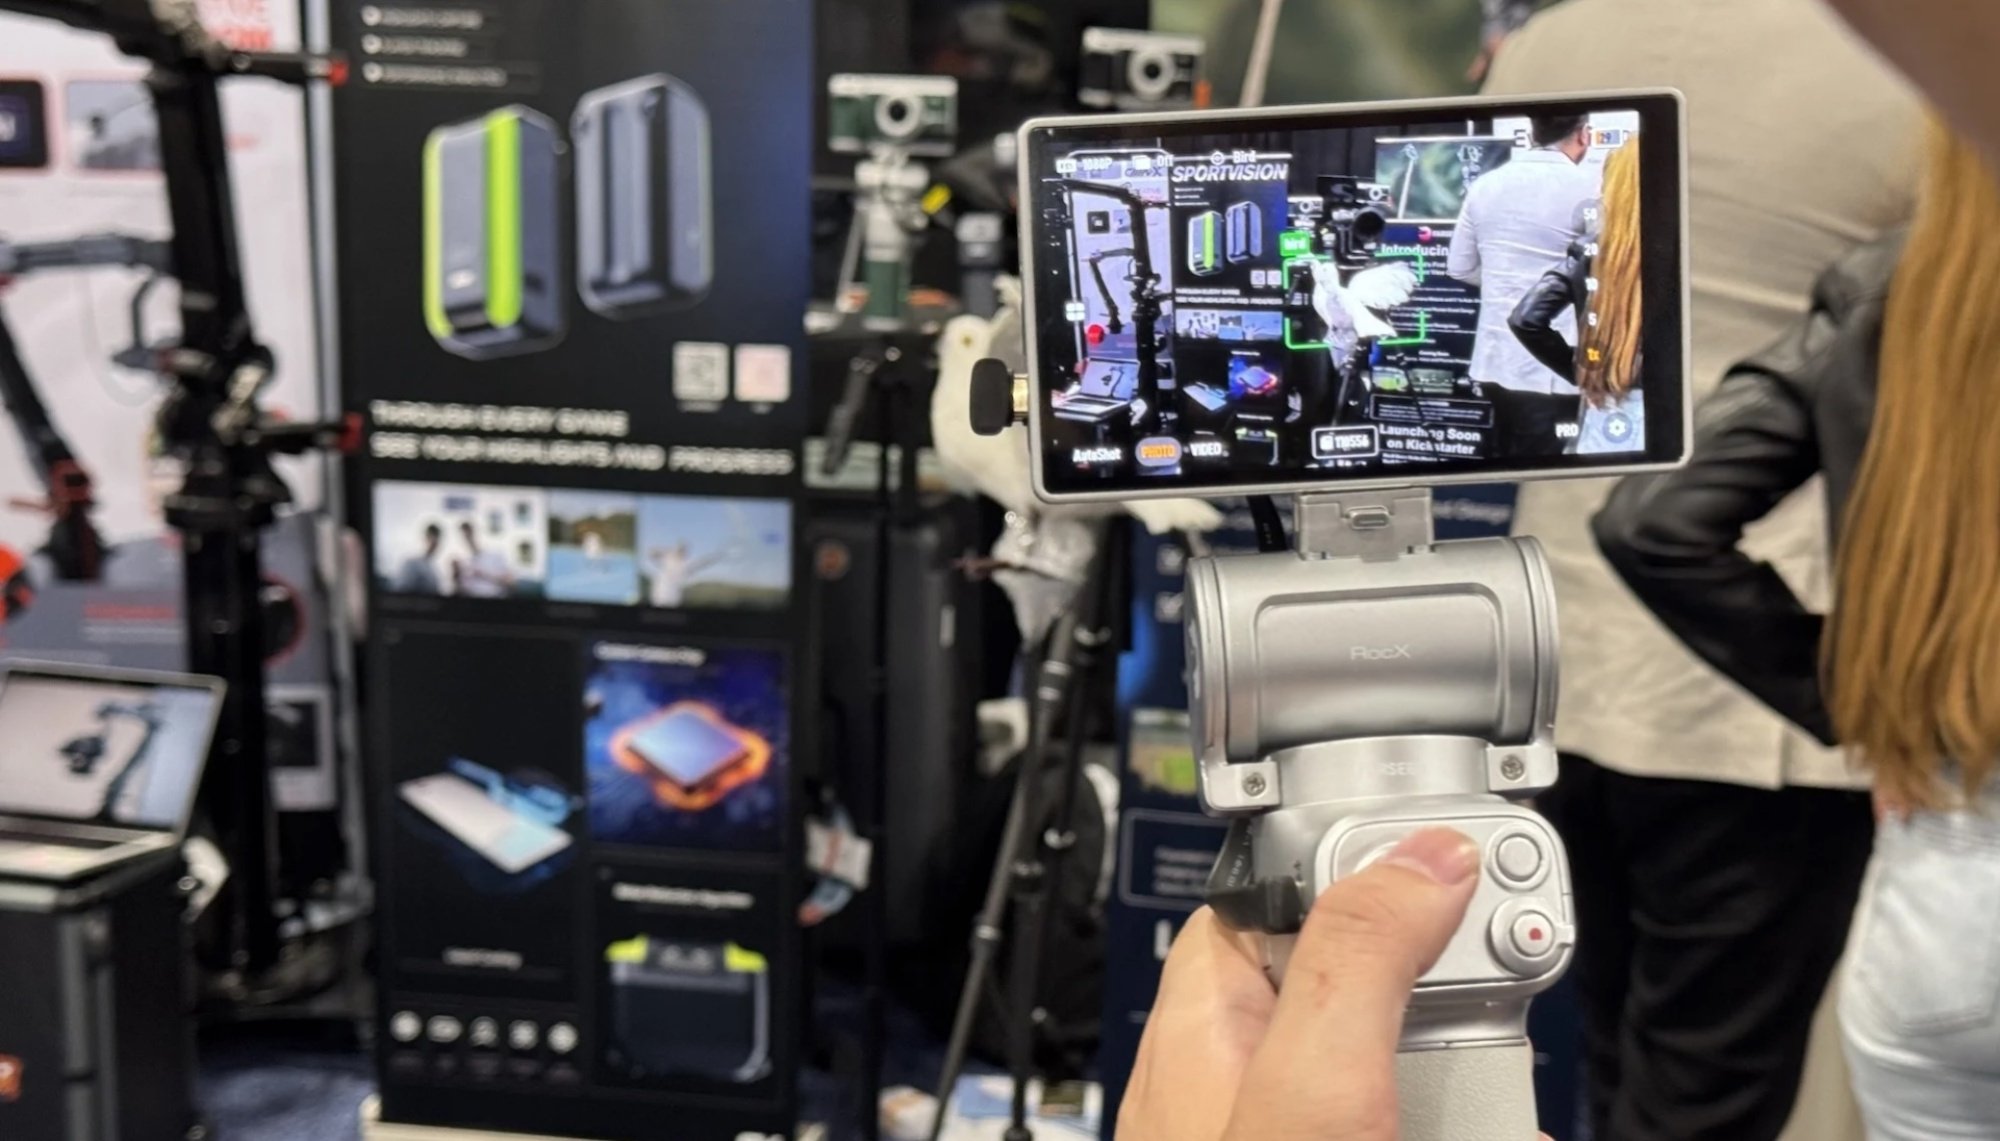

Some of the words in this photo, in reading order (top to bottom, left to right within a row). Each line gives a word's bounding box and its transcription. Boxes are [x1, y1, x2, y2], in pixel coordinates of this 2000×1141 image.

[1156, 153, 1174, 168] Off
[1232, 150, 1256, 164] Bird
[1171, 164, 1289, 182] SPORTVISION
[1381, 243, 1450, 257] Introducin
[1584, 242, 1599, 256] 20
[1447, 427, 1481, 442] Soon
[1555, 423, 1579, 438] PRO
[1386, 439, 1403, 449] on
[1072, 447, 1121, 463] AutoShot
[1190, 442, 1222, 457] VIDEO
[1350, 643, 1411, 661] RocX
